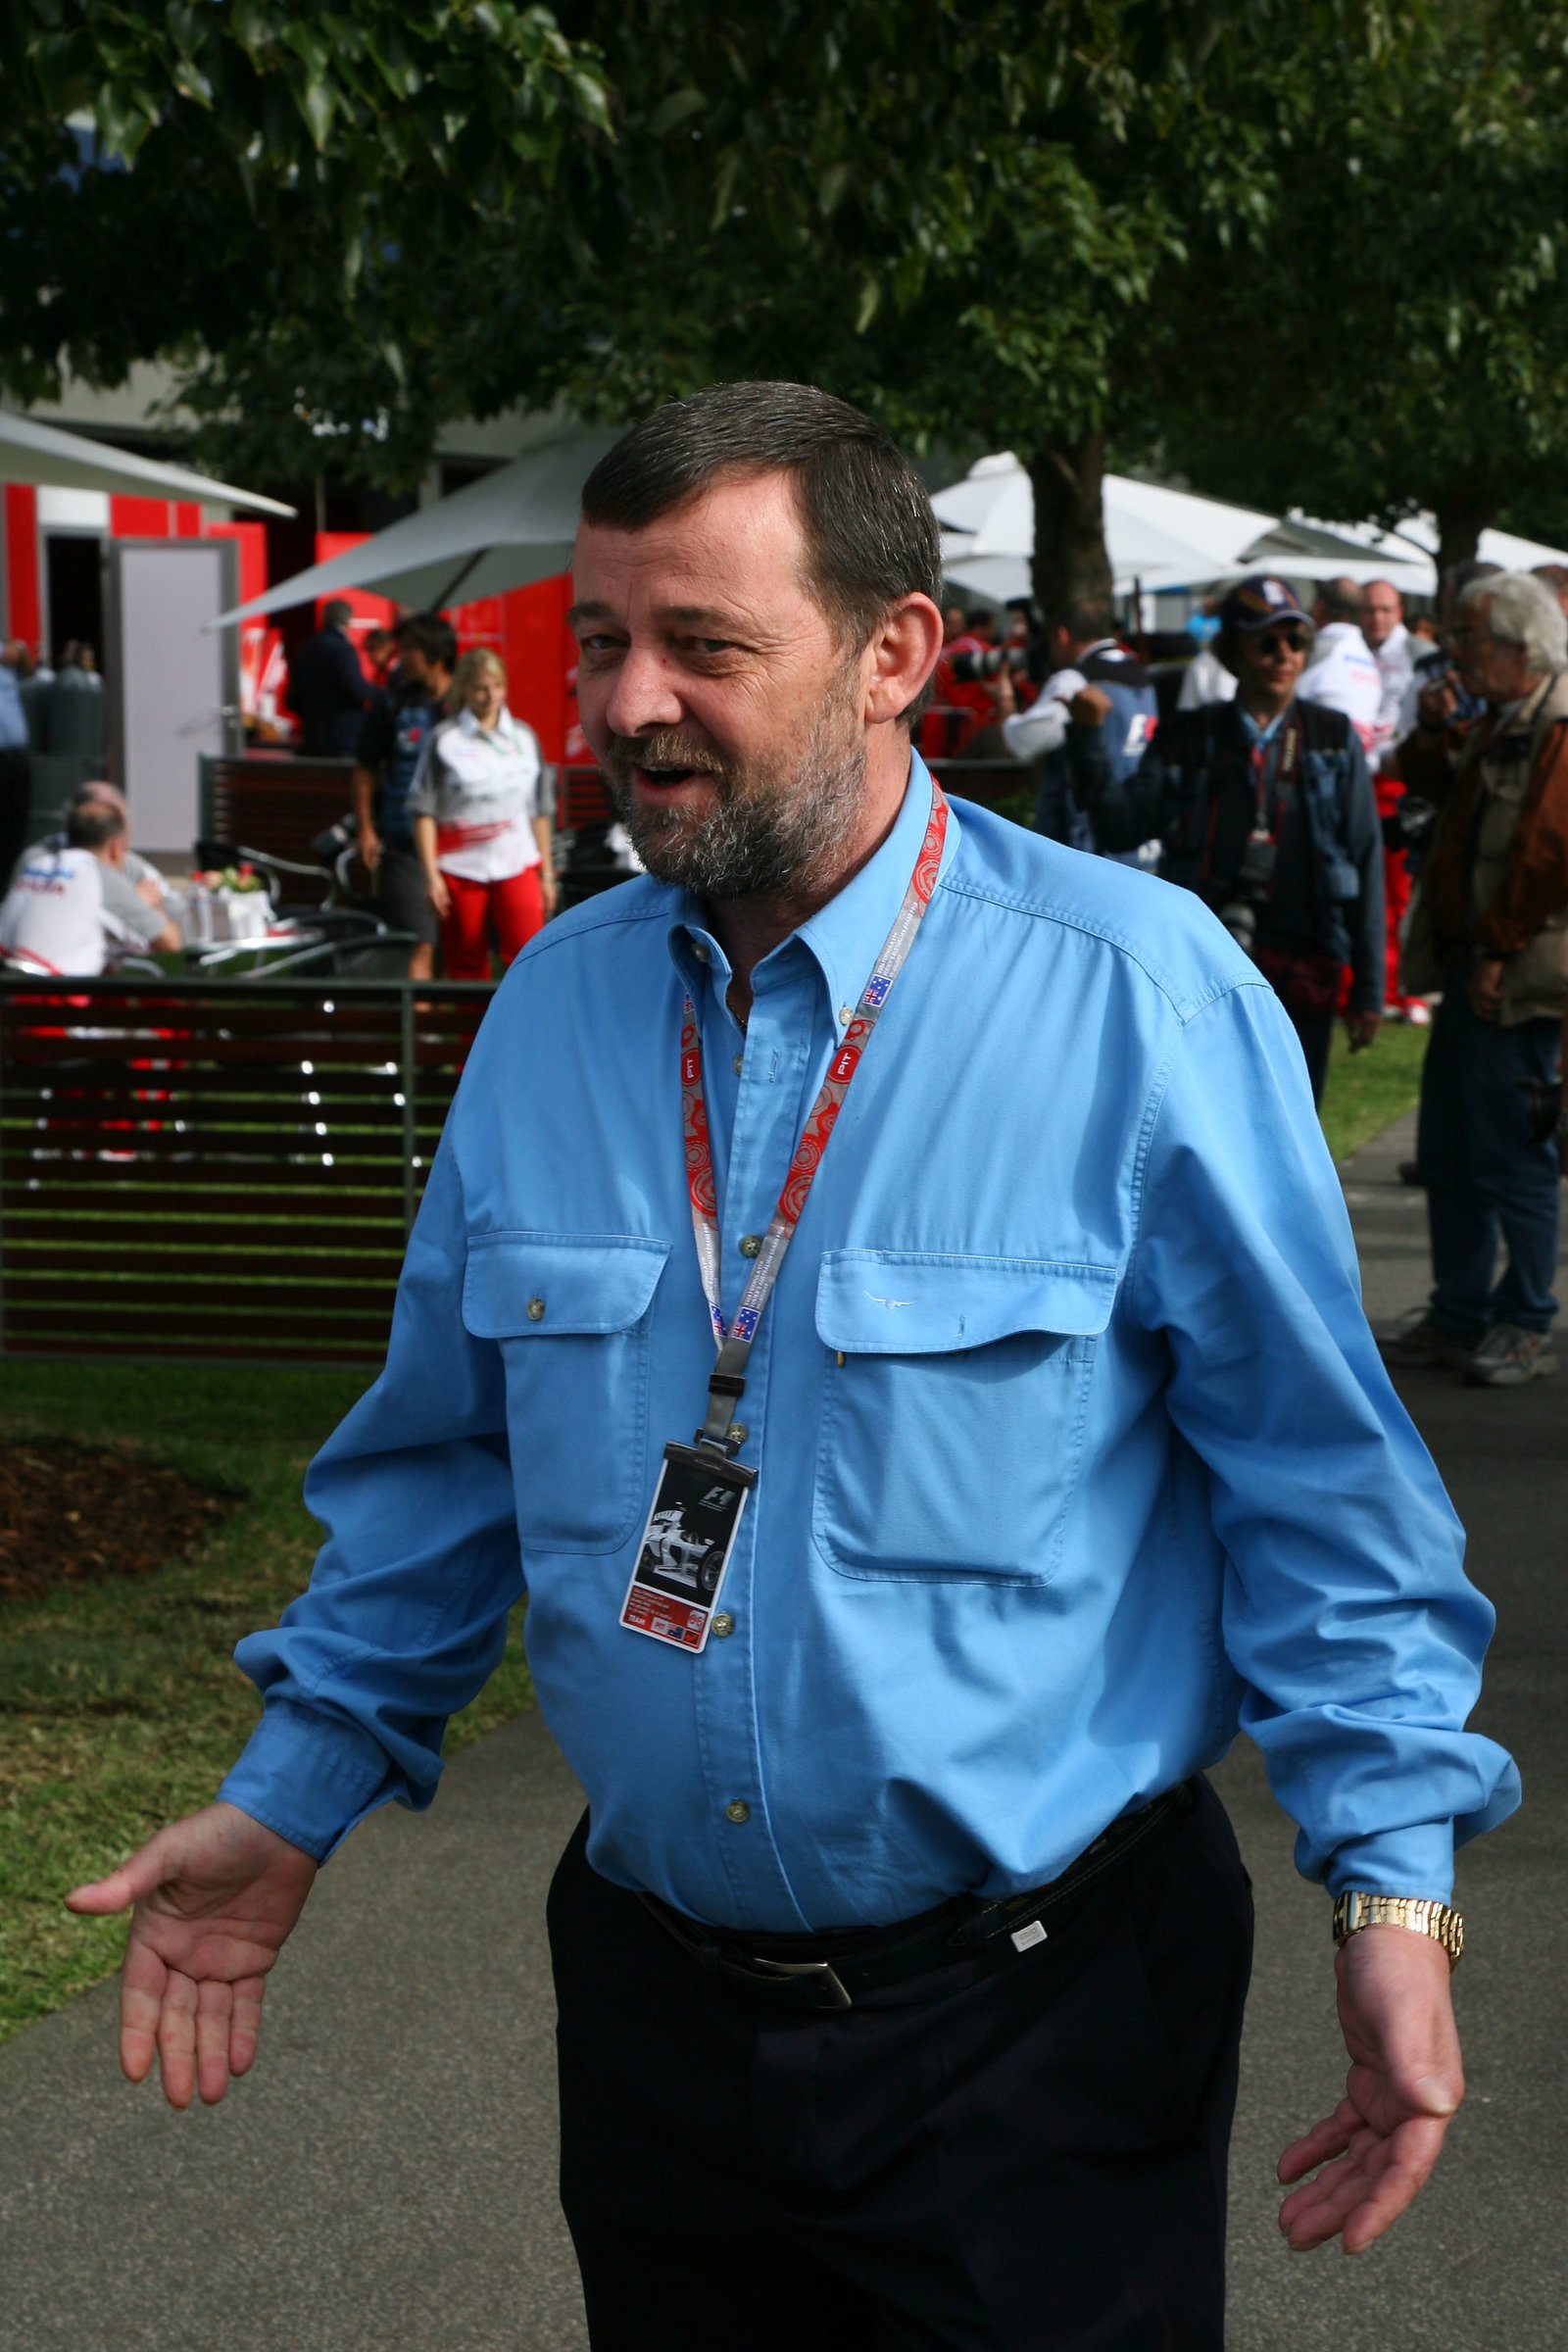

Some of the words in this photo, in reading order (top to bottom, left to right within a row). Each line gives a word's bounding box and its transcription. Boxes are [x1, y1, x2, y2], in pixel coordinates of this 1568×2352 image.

[686, 1057, 695, 1079] PIT
[838, 1053, 852, 1075] PIT
[628, 1613, 646, 1627] TEAM
